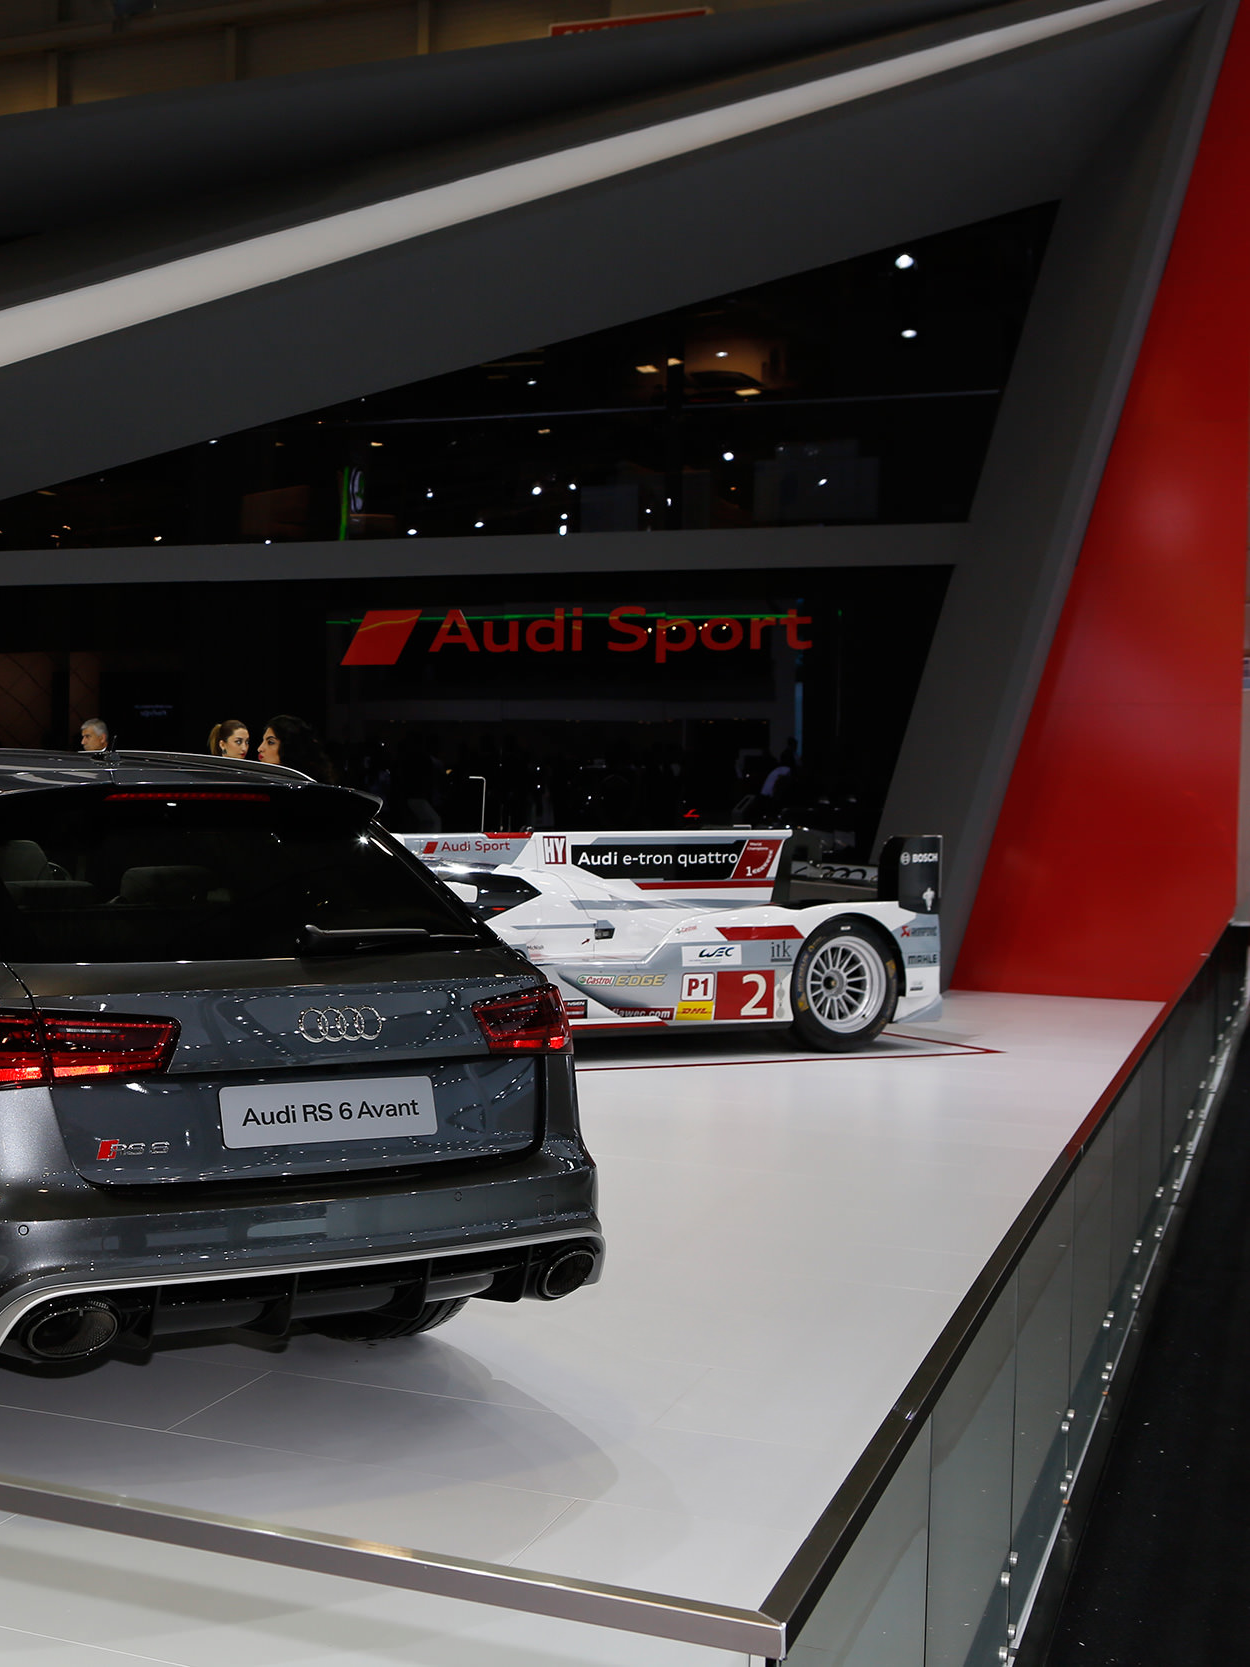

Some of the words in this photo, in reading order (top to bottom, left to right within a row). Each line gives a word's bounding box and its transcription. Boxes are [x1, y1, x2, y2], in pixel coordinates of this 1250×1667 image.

[427, 606, 584, 653] Audi
[606, 605, 814, 664] Sport
[441, 841, 471, 852] Audi
[475, 840, 511, 854] Sport
[543, 836, 566, 864] HY
[577, 851, 618, 866] Audi
[622, 852, 674, 866] e-tron
[677, 851, 738, 868] quattro
[911, 853, 939, 864] BOSCH
[698, 946, 735, 958] WEC
[770, 940, 791, 958] itk
[908, 954, 938, 964] MAHLE
[584, 976, 614, 985] Castrol
[614, 974, 666, 987] EDGE
[687, 978, 708, 996] P1
[740, 973, 768, 1016] 2
[242, 1105, 297, 1127] Audi
[302, 1103, 334, 1123] RS
[338, 1101, 353, 1121] 6
[357, 1098, 420, 1120] Avant
